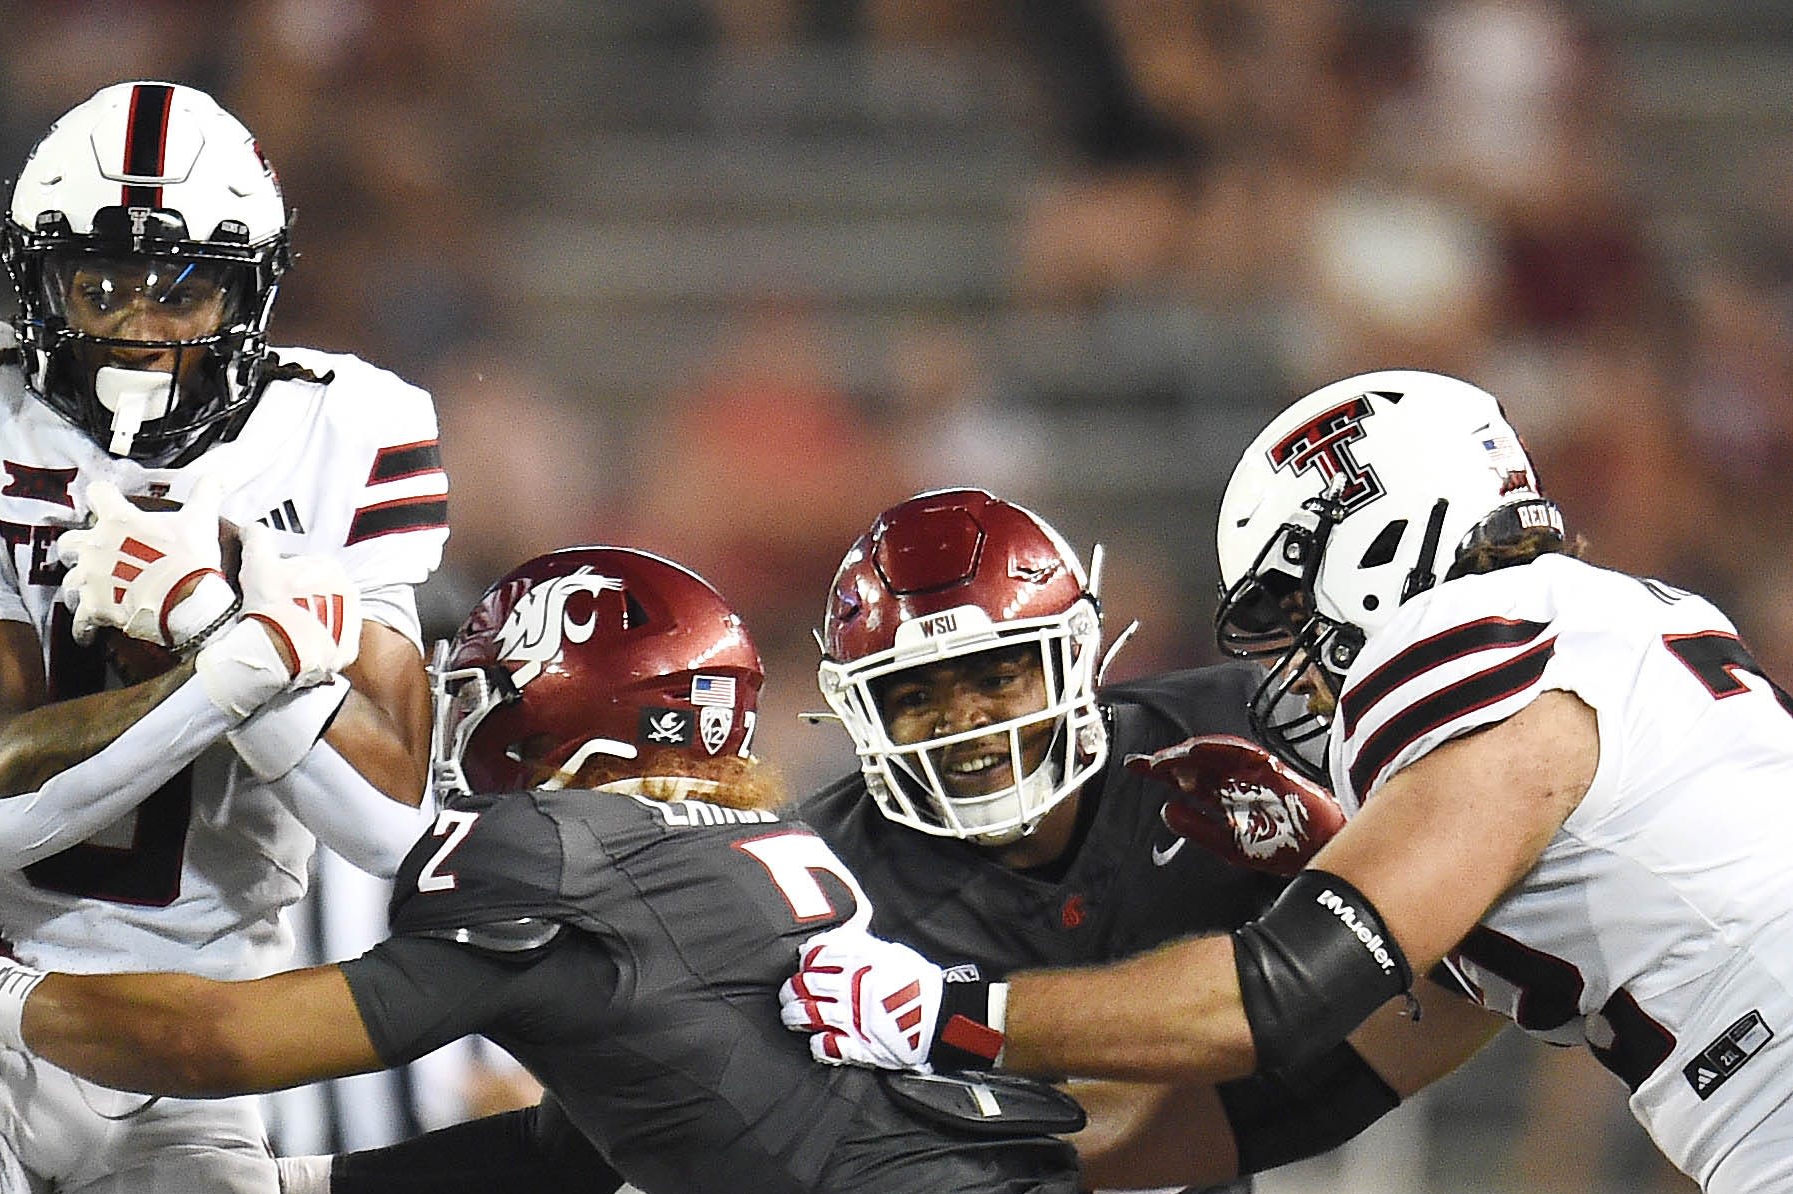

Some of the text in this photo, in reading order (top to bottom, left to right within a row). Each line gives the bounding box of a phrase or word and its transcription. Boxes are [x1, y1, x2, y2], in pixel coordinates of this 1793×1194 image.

[1518, 504, 1549, 529] RED
[919, 613, 958, 638] WSU
[416, 808, 482, 895] 2
